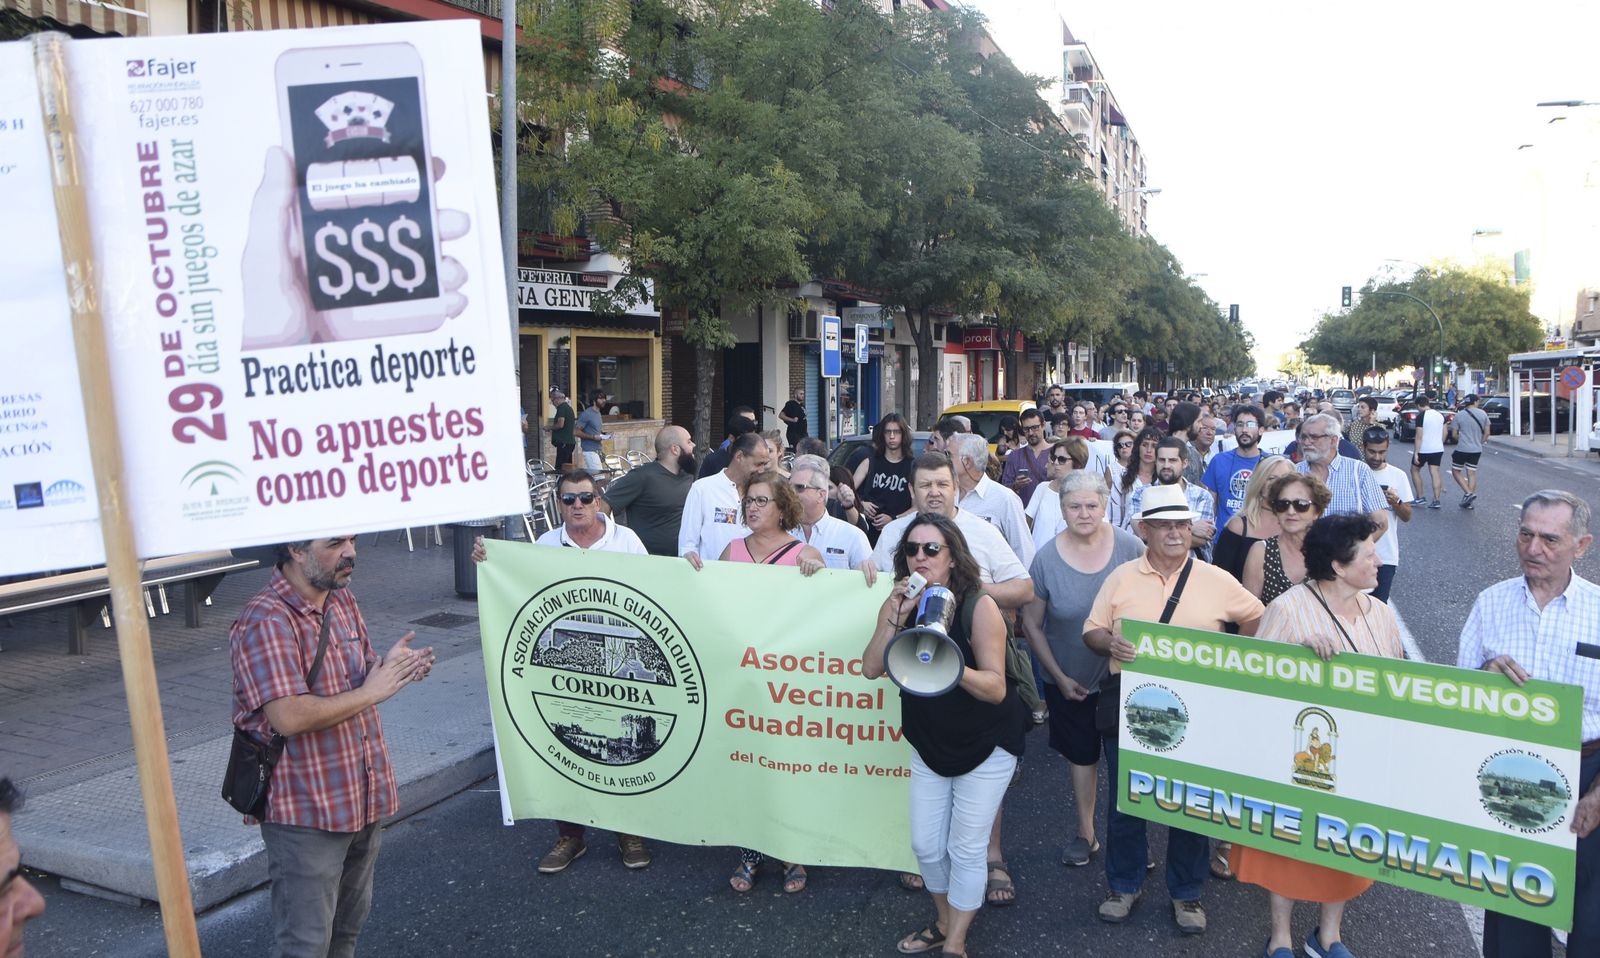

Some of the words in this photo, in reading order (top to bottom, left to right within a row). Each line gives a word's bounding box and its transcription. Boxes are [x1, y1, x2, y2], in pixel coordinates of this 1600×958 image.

[147, 58, 196, 79] fajer
[130, 99, 152, 113] 627
[156, 97, 178, 112] 000
[181, 95, 204, 110] 780
[139, 114, 199, 131] fajer.es
[171, 138, 197, 184] azar
[168, 190, 200, 217] de
[136, 140, 178, 318] OCTUBRE
[178, 223, 223, 296] juegos
[518, 269, 573, 285] FETERIA
[182, 300, 216, 335] sin
[160, 330, 186, 378] DE
[964, 335, 991, 344] proxi
[187, 340, 220, 375] día
[241, 349, 362, 398] Practica
[371, 337, 476, 393] deporte
[1, 391, 43, 405] RESAS
[168, 382, 227, 444] 29
[0, 440, 52, 457] ACIÓN
[249, 418, 303, 461] No
[315, 402, 485, 463] apuestes
[256, 466, 346, 506] como
[358, 443, 489, 502] deporte
[512, 597, 563, 679] ASOCIACIÓN
[562, 588, 619, 607] VECINAL
[623, 597, 700, 705] GUADALQUIVIR
[740, 646, 887, 679] Asociac
[551, 674, 655, 705] CORDOBA
[767, 681, 884, 710] Vecinal
[1138, 635, 1321, 685] ASOCIACION
[1332, 667, 1375, 693] DE
[1388, 674, 1557, 723] VECINOS
[724, 708, 902, 745] Guadalquiv
[547, 744, 585, 777] CAMPO
[587, 771, 601, 783] DE
[603, 776, 616, 787] LA
[618, 771, 656, 788] VERDAD
[730, 751, 753, 764] del
[758, 756, 812, 775] Campo
[818, 762, 838, 774] de
[844, 763, 858, 775] la
[864, 764, 911, 778] Verda
[1476, 748, 1524, 781] ASOCIACIÓN
[1527, 751, 1543, 760] DE
[1545, 758, 1573, 801] VECINOS
[1128, 769, 1304, 844] PUENTE
[1315, 813, 1557, 906] ROMANO
[1520, 815, 1566, 834] ROMANO
